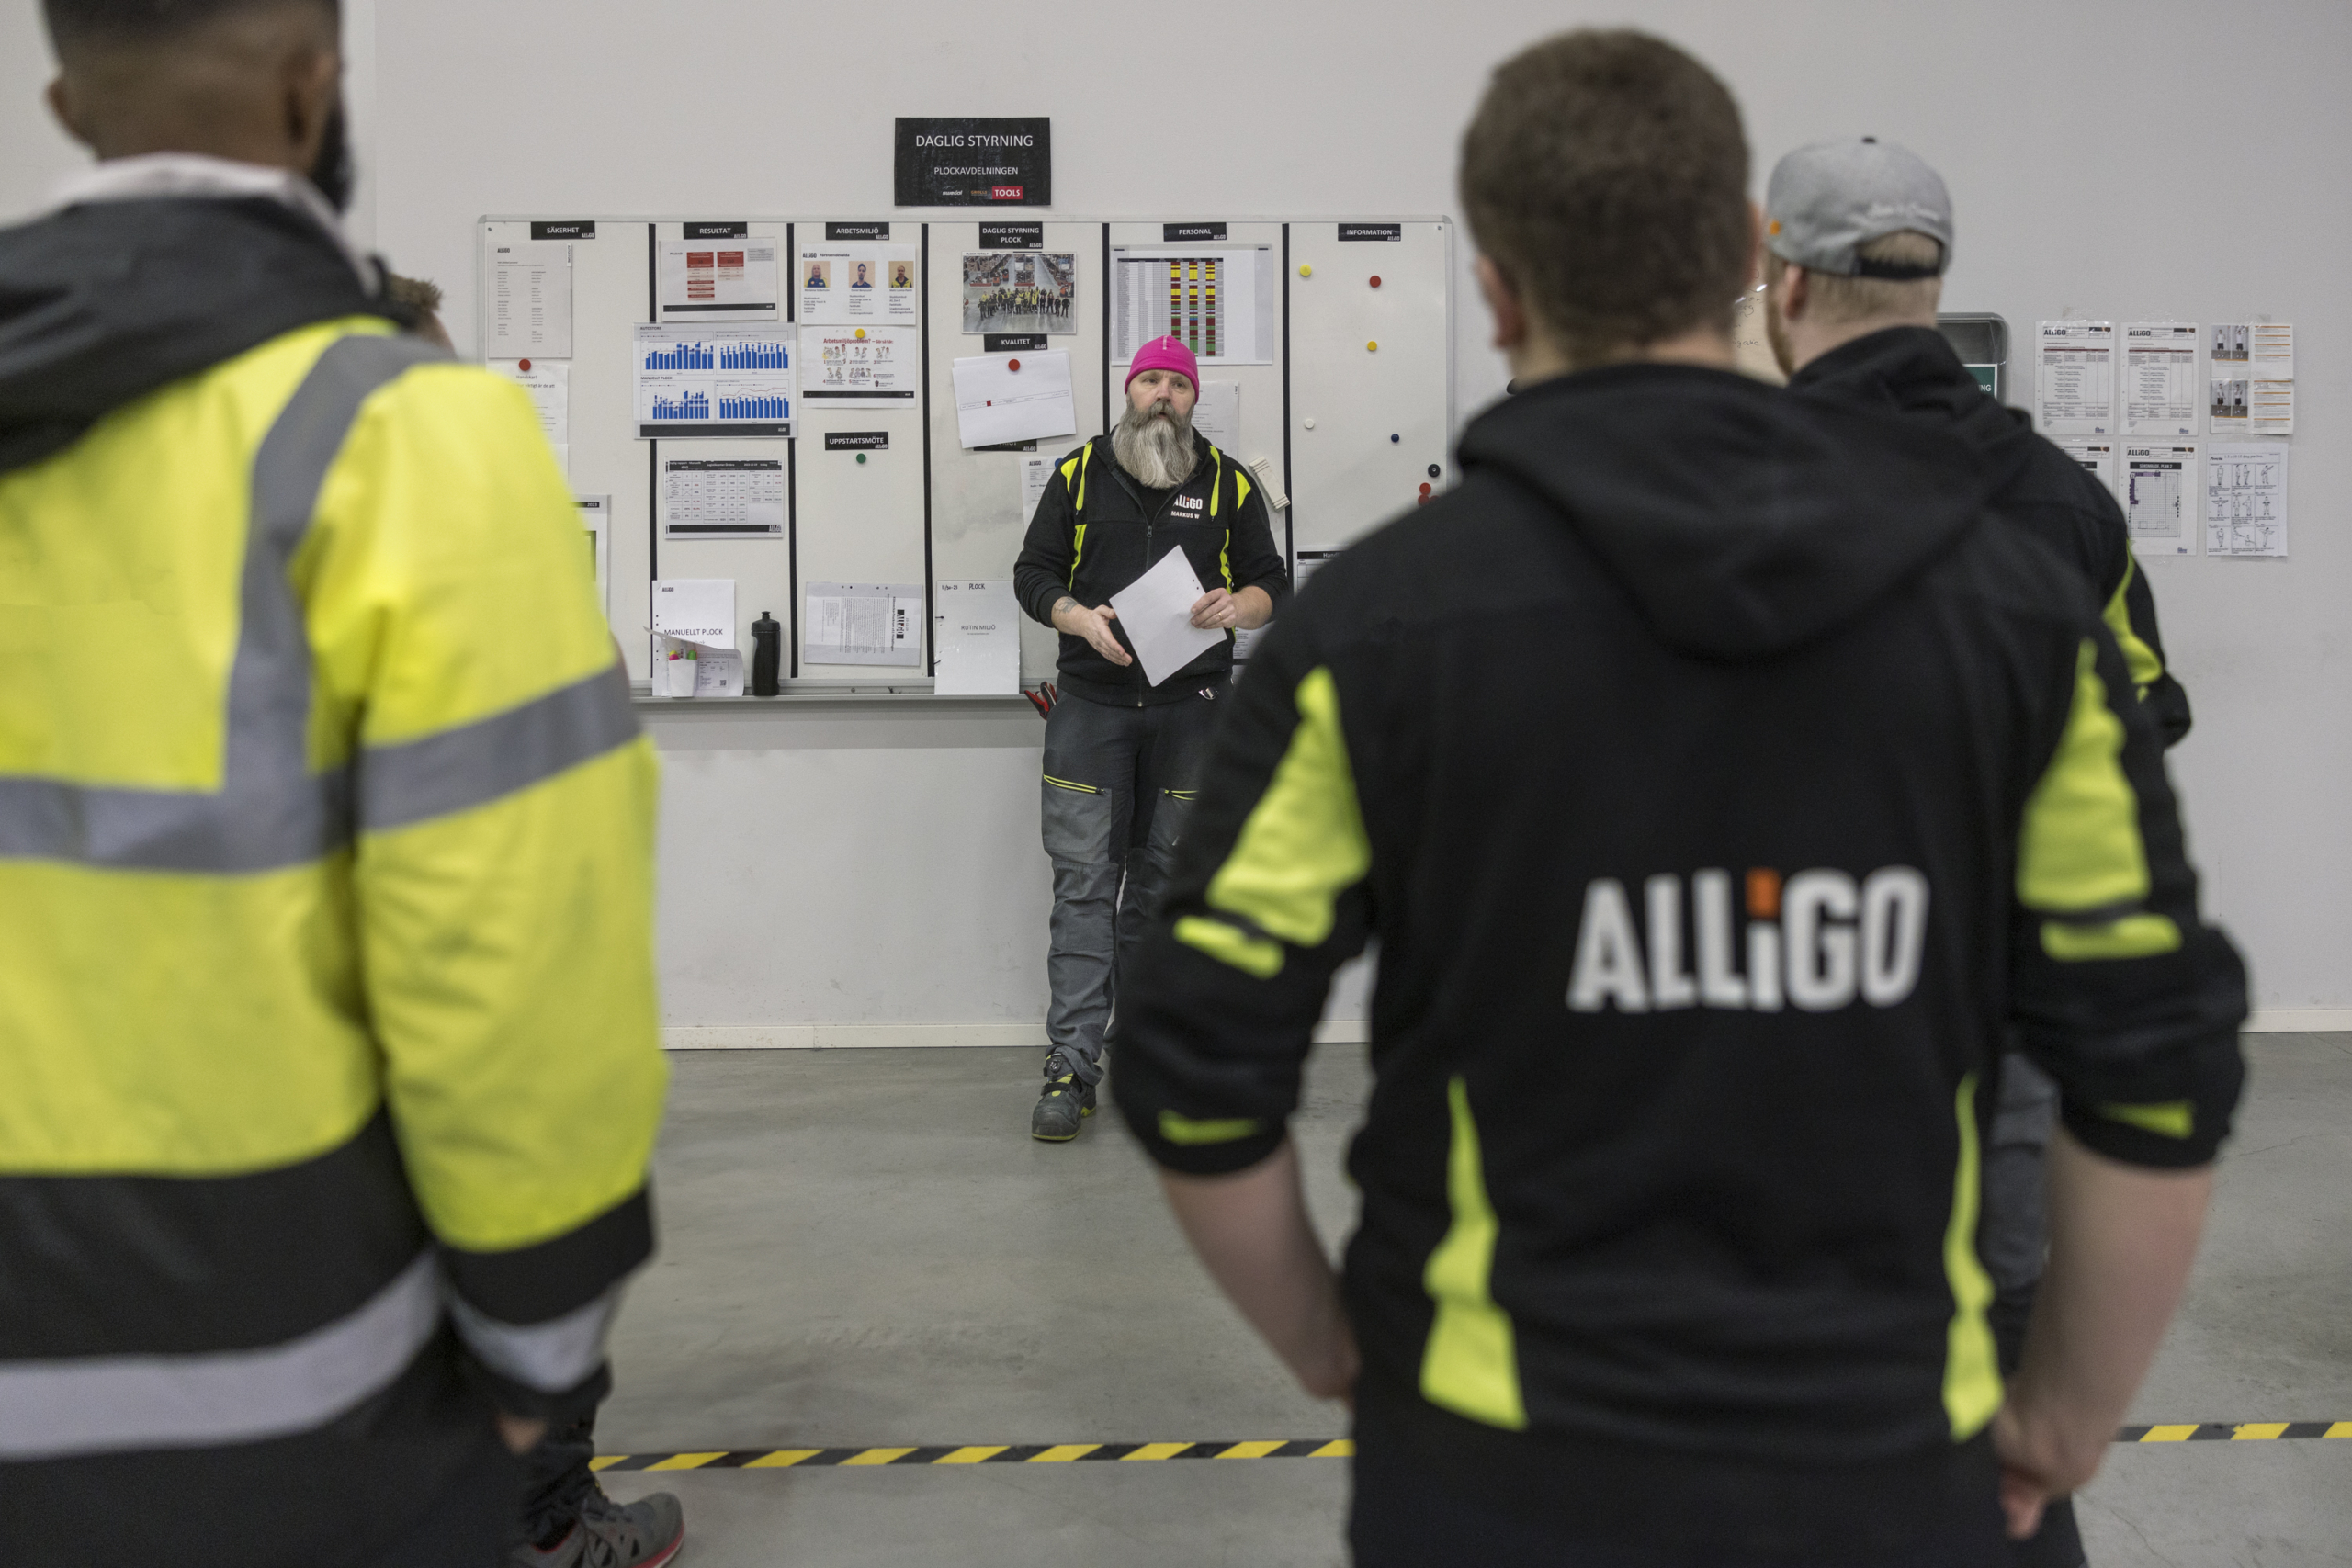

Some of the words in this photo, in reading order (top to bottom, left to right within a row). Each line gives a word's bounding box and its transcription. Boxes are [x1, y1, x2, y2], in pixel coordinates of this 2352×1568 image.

[916, 135, 965, 147] DAGLIG
[967, 135, 1034, 147] STYRNING
[933, 166, 1019, 175] PLOCKAVDELNINGEN
[547, 226, 580, 234] SÄKERHET
[829, 436, 884, 445] UPPSTARTSMÖTE
